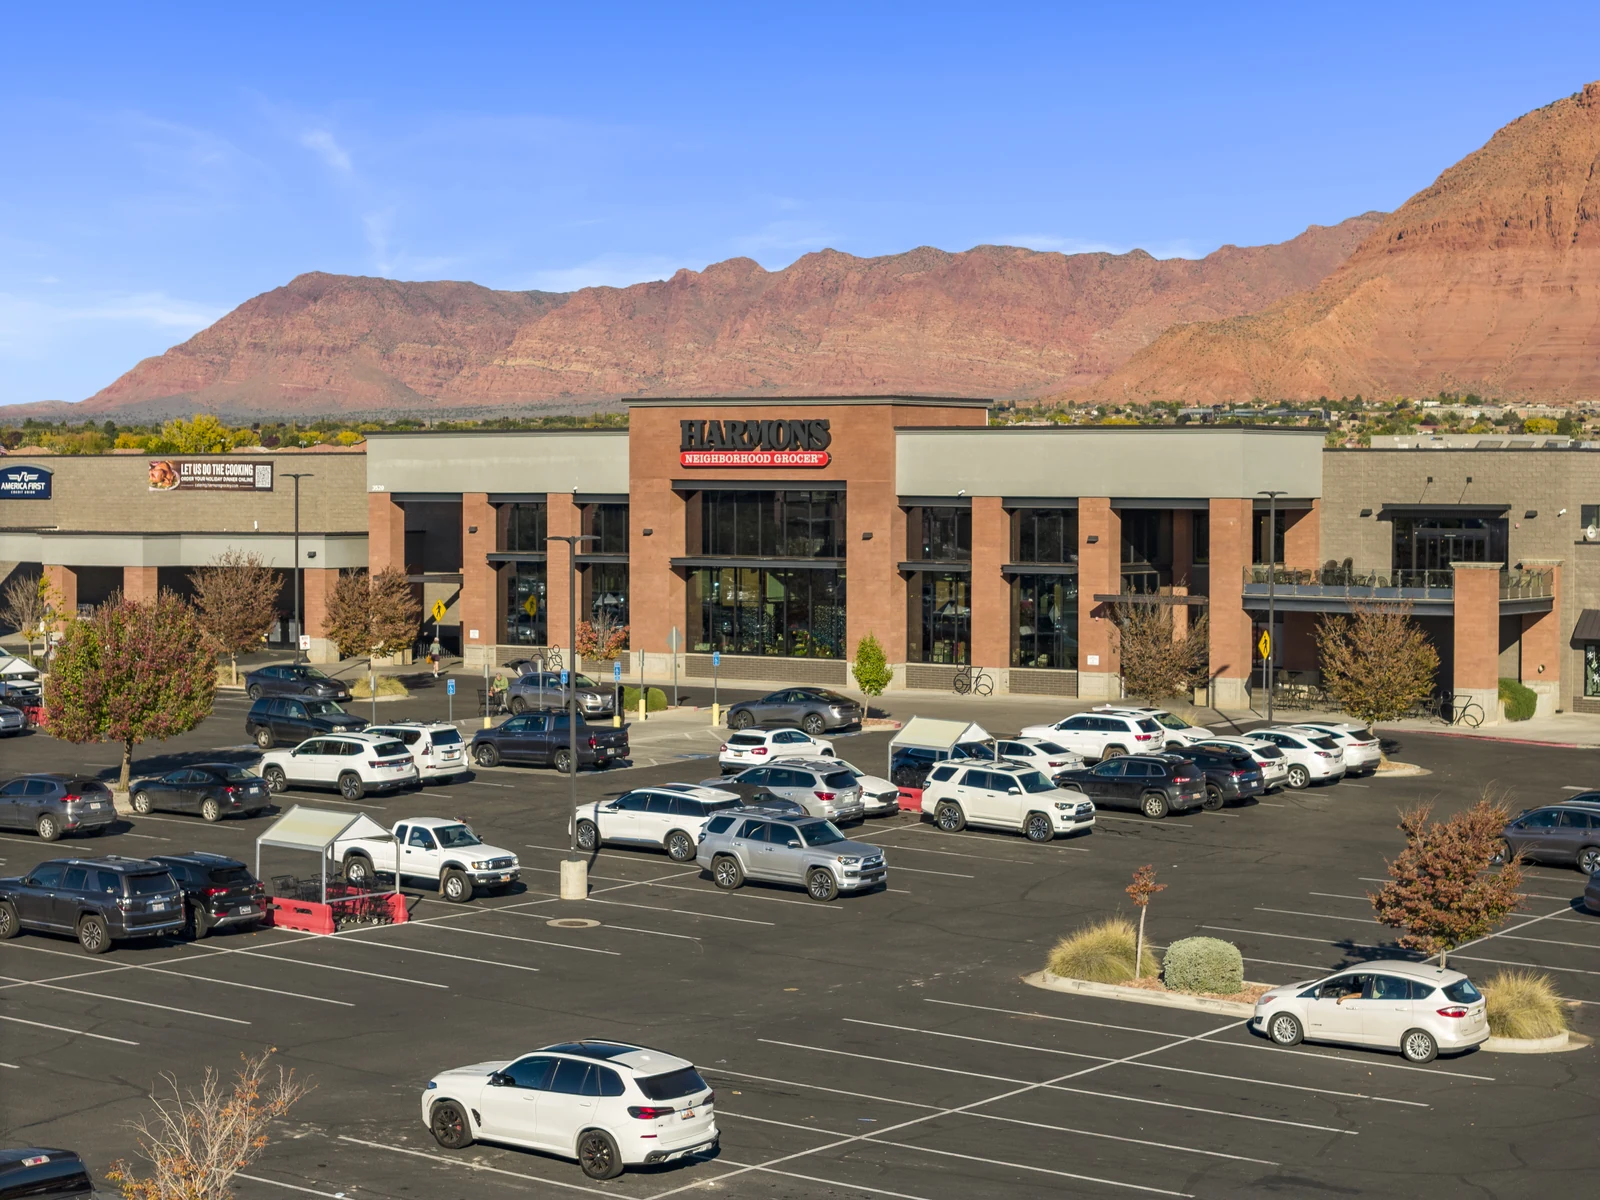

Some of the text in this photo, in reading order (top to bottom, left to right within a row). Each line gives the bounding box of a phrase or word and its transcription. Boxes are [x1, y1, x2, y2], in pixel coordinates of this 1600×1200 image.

[680, 419, 831, 451] HARMONS
[685, 454, 771, 464] NEIGHBORHOOD
[181, 464, 253, 475] LET US DO THE COOKING
[1, 482, 45, 490] AMERICA FIRST
